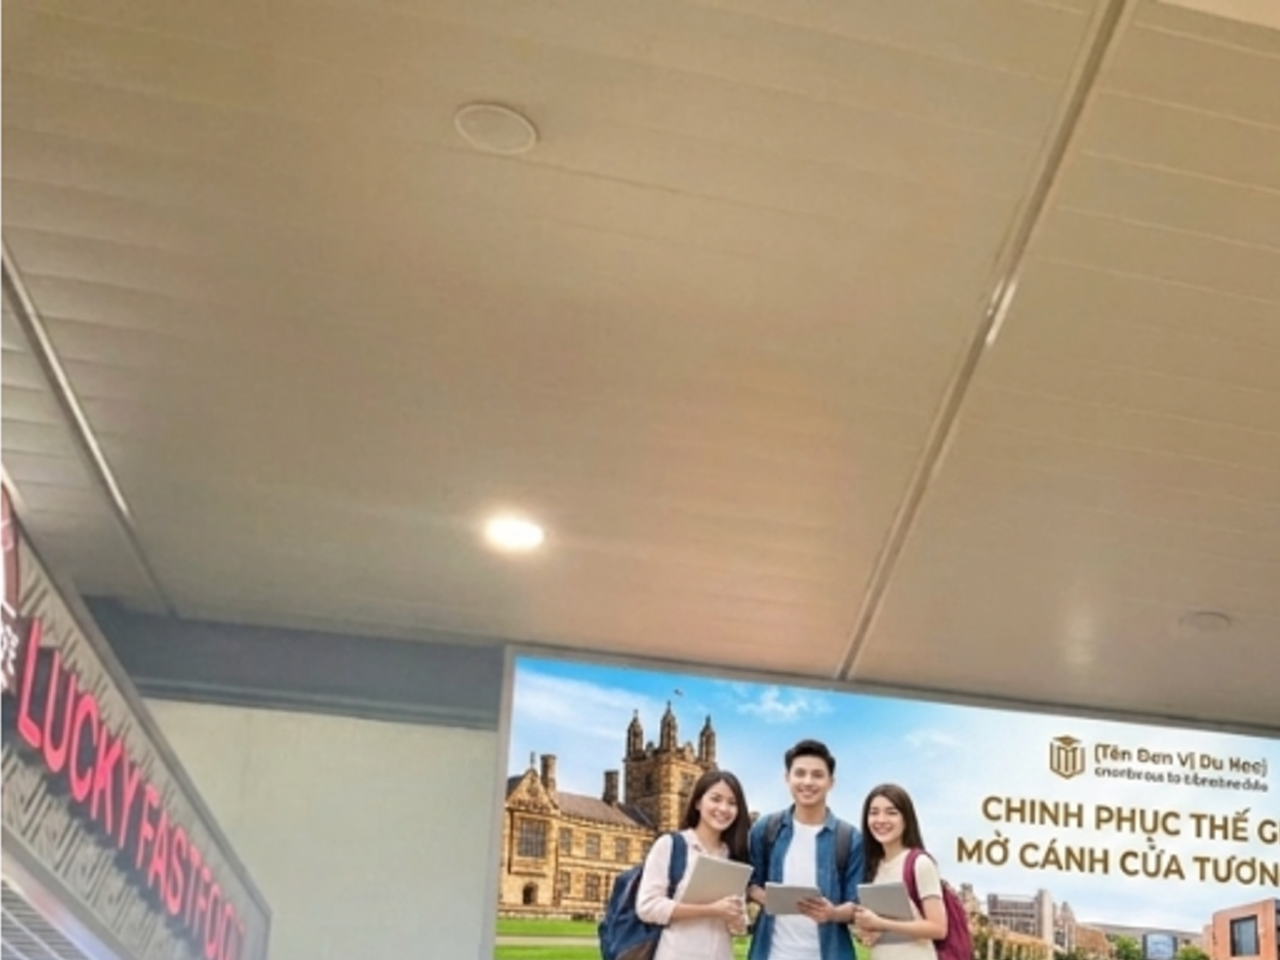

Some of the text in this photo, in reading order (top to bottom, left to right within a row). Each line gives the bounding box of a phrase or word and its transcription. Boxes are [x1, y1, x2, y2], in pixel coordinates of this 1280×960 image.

[18, 617, 142, 849] LUCKY
[982, 796, 1083, 828] CHINH
[1095, 804, 1181, 843] PHỤC
[1189, 808, 1251, 842] THẾ
[1018, 839, 1109, 875] CÁNH
